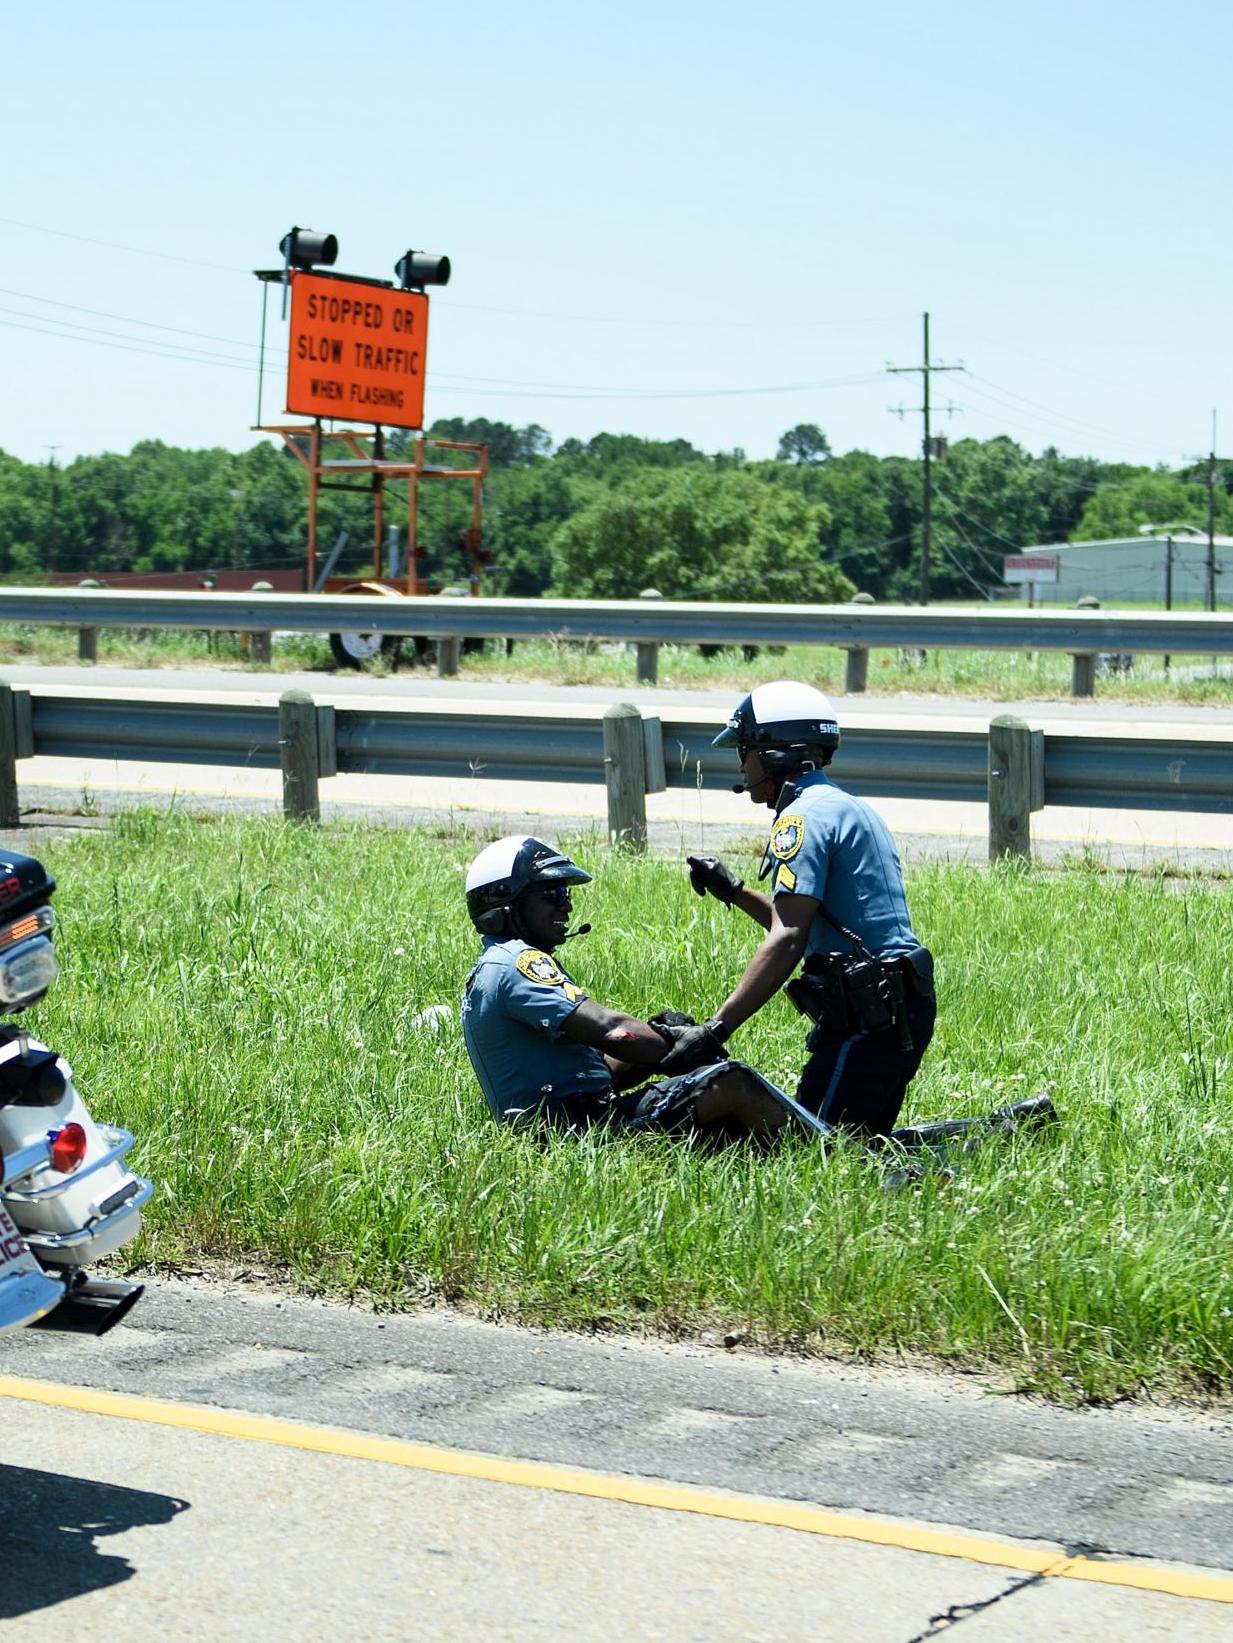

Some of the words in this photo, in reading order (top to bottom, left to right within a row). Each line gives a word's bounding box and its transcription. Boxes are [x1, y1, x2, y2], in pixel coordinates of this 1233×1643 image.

[308, 293, 383, 329] STOPPED
[393, 308, 414, 335] OR
[297, 334, 343, 364] SLOW
[355, 342, 419, 375] TRAFFIC
[310, 378, 344, 401] WHEN
[351, 383, 404, 408] FLASHING
